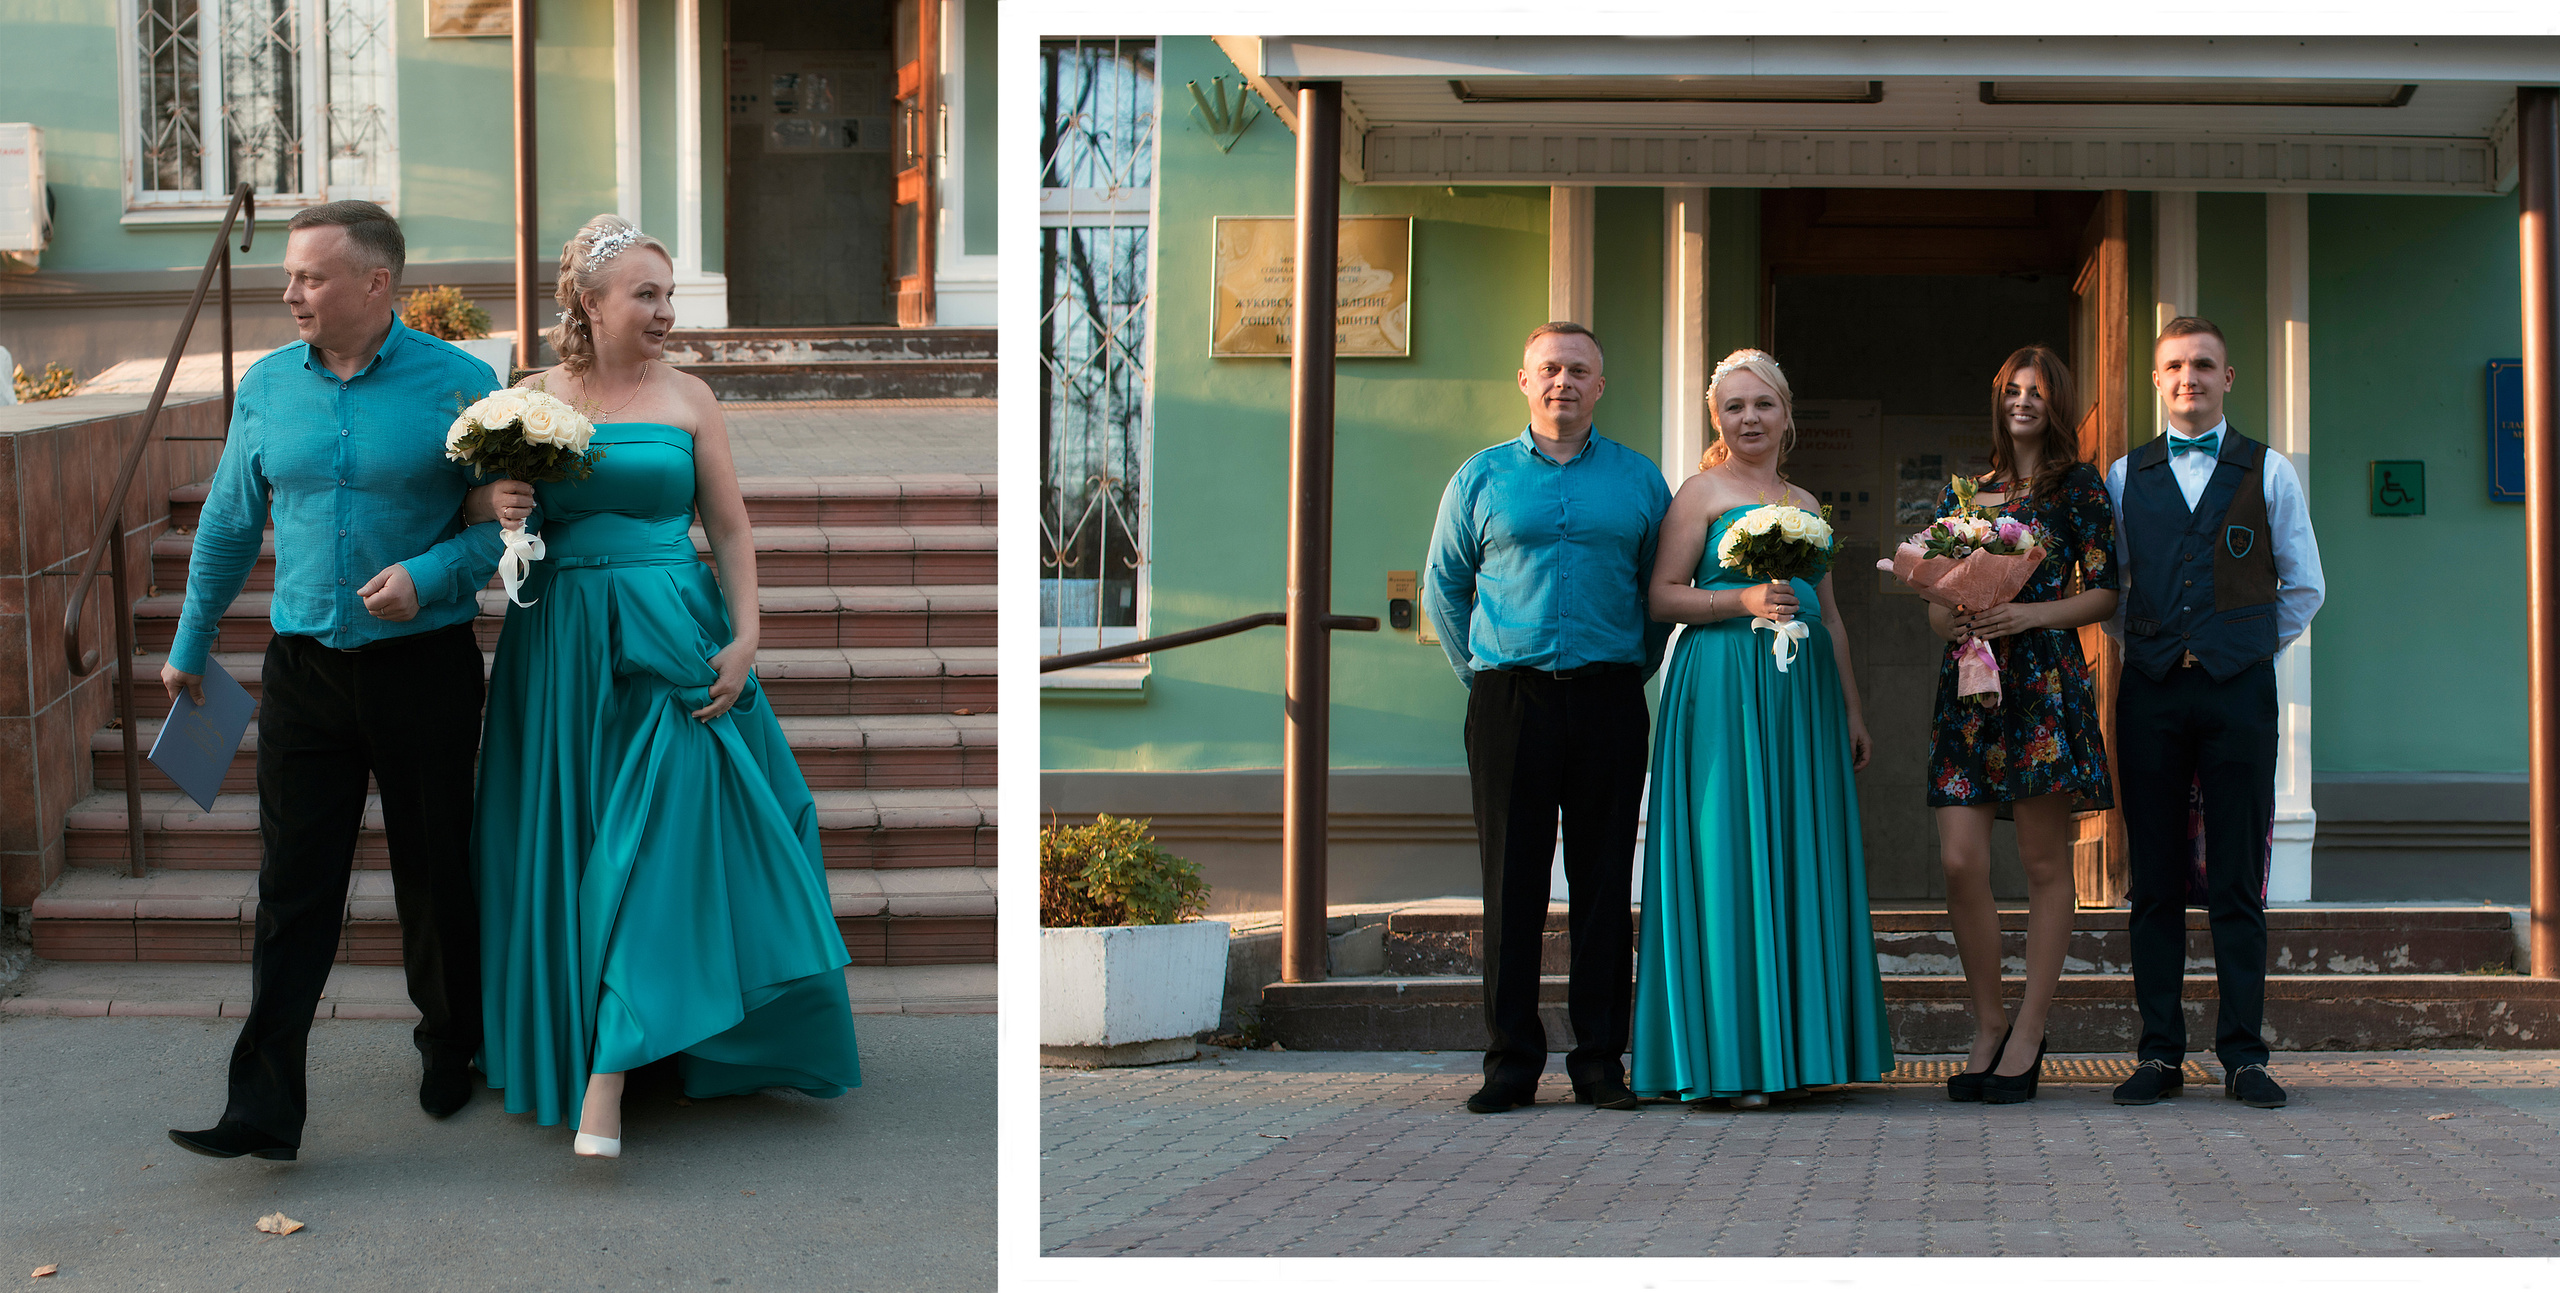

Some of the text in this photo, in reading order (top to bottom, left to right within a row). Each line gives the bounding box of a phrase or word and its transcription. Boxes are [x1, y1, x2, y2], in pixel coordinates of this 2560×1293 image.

[1235, 297, 1293, 308] ЖУКОВСК
[1240, 315, 1380, 327] СОЦИАЛ АЩИТЫ
[1796, 427, 1853, 439] ОЛУЧИТЕ
